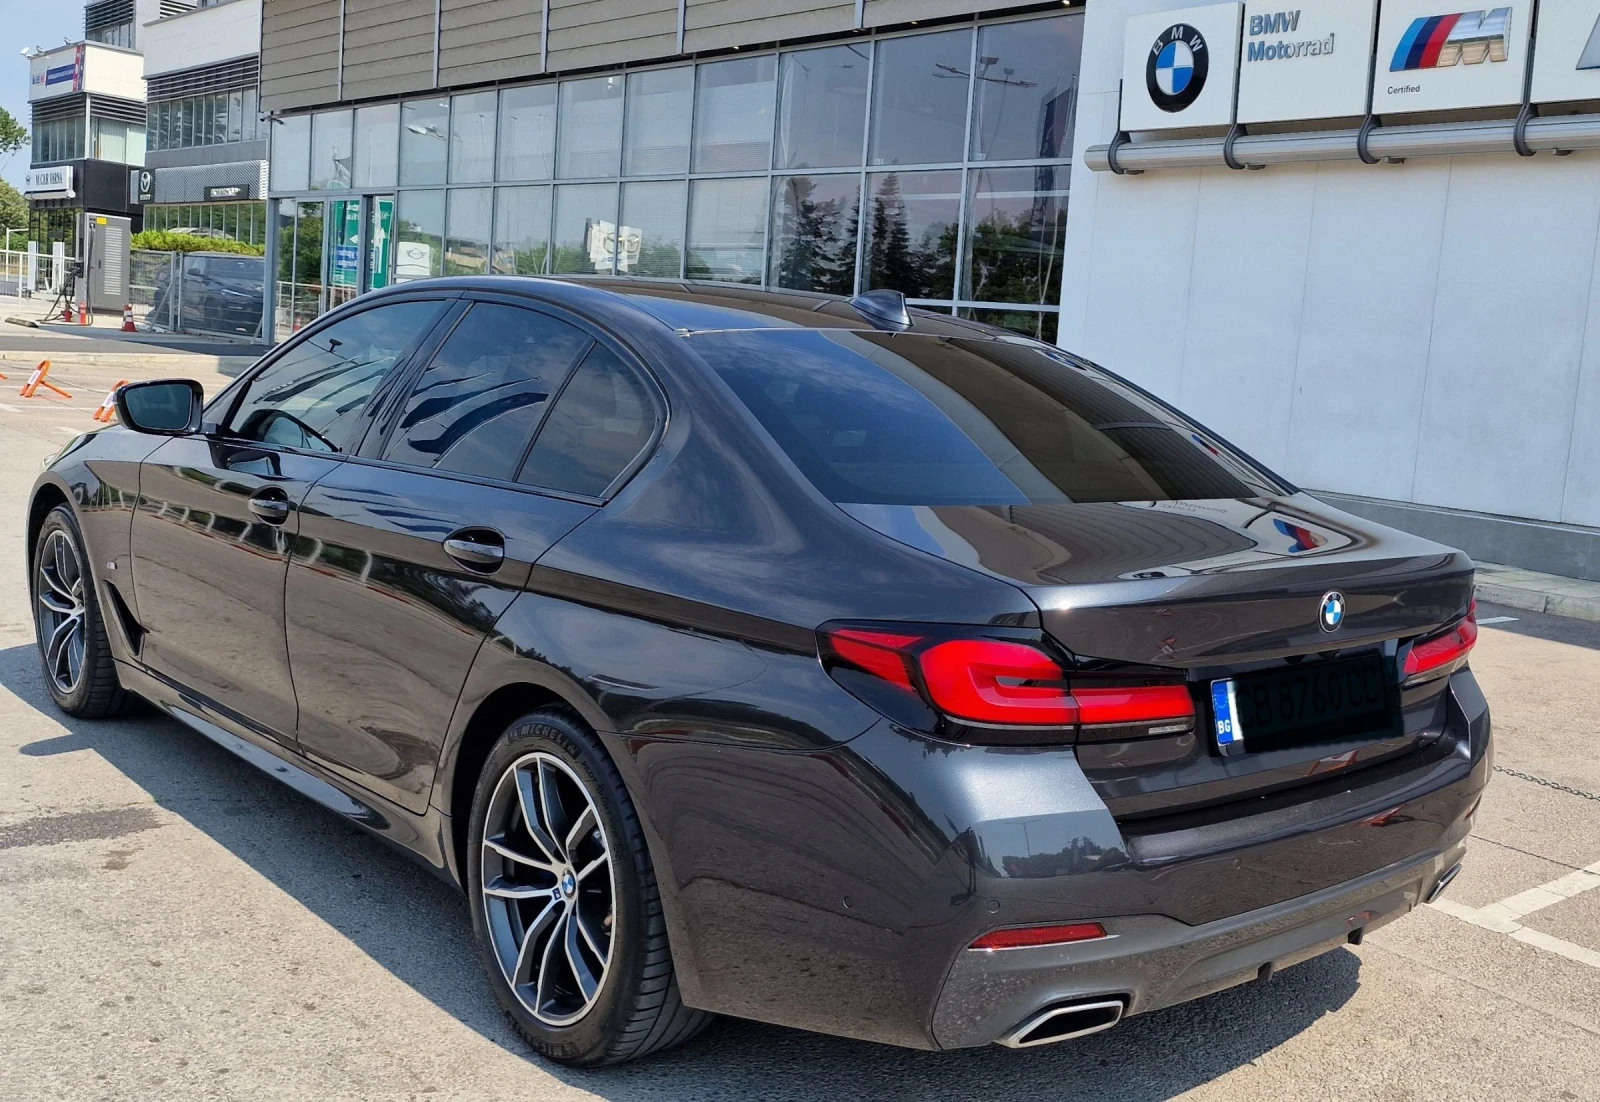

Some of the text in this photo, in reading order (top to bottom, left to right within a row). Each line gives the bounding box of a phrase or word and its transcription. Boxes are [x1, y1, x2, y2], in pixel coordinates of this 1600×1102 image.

[1249, 10, 1301, 36] BMW
[1152, 25, 1204, 56] BMW
[1247, 32, 1335, 62] Motorrad
[1387, 84, 1421, 95] Certified
[1217, 719, 1232, 735] BG
[520, 723, 581, 760] MICHELIN
